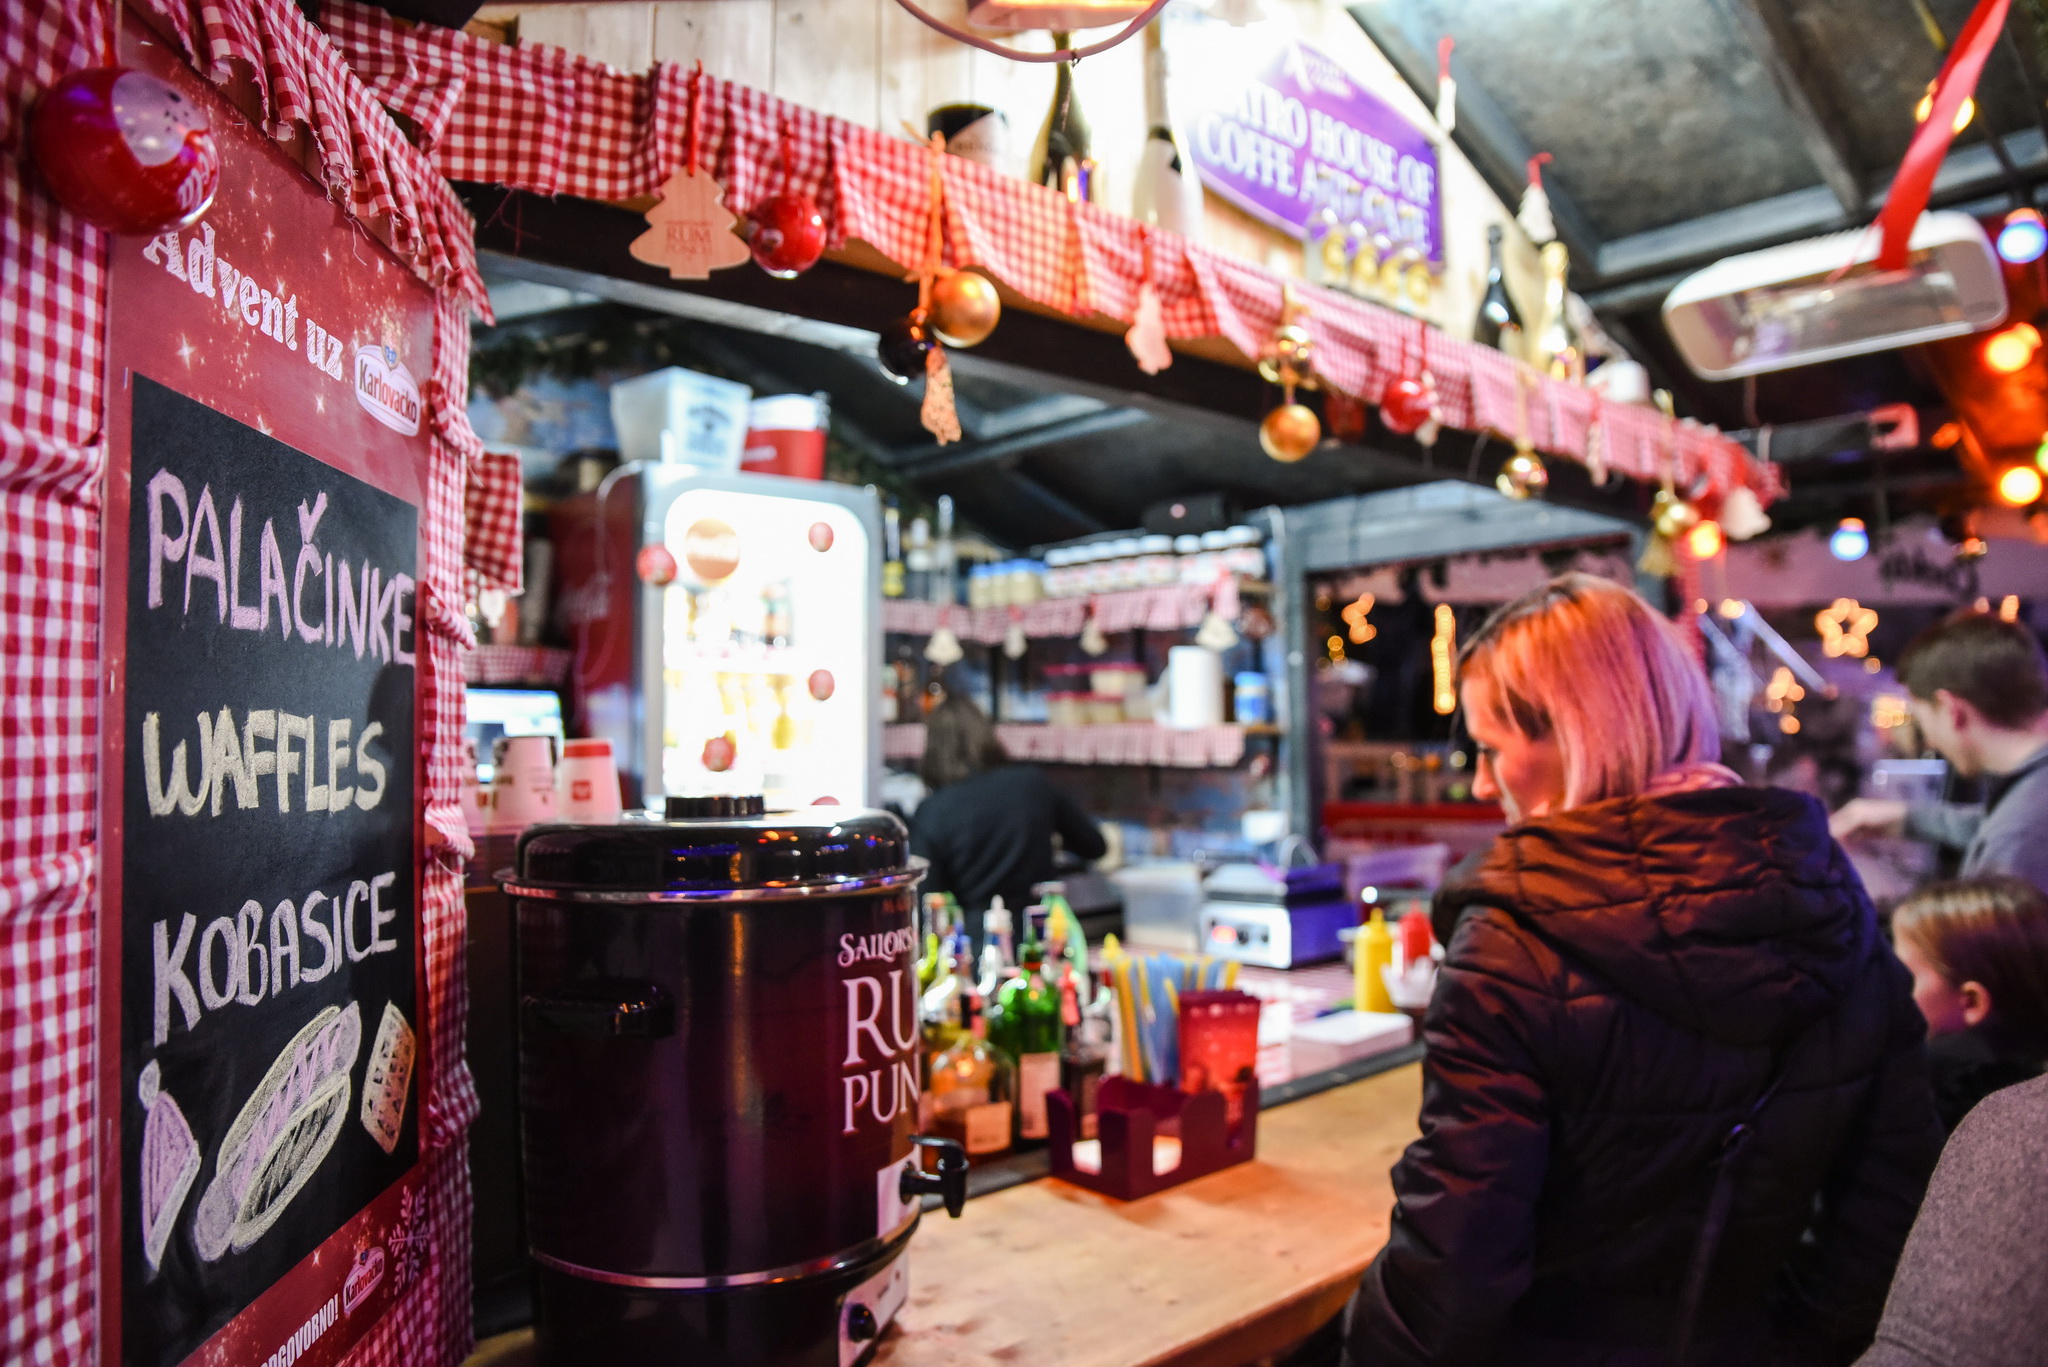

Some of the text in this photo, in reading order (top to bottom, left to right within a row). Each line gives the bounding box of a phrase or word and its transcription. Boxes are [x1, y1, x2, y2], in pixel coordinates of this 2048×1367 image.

[1309, 107, 1399, 193] HOUSE
[1398, 154, 1436, 208] OF
[143, 221, 344, 382] Advent uz
[146, 466, 415, 666] PALAČINKE
[142, 704, 387, 818] WAFFLES
[152, 870, 397, 1049] KOBASICE
[261, 1292, 339, 1367] GOVORNO!
